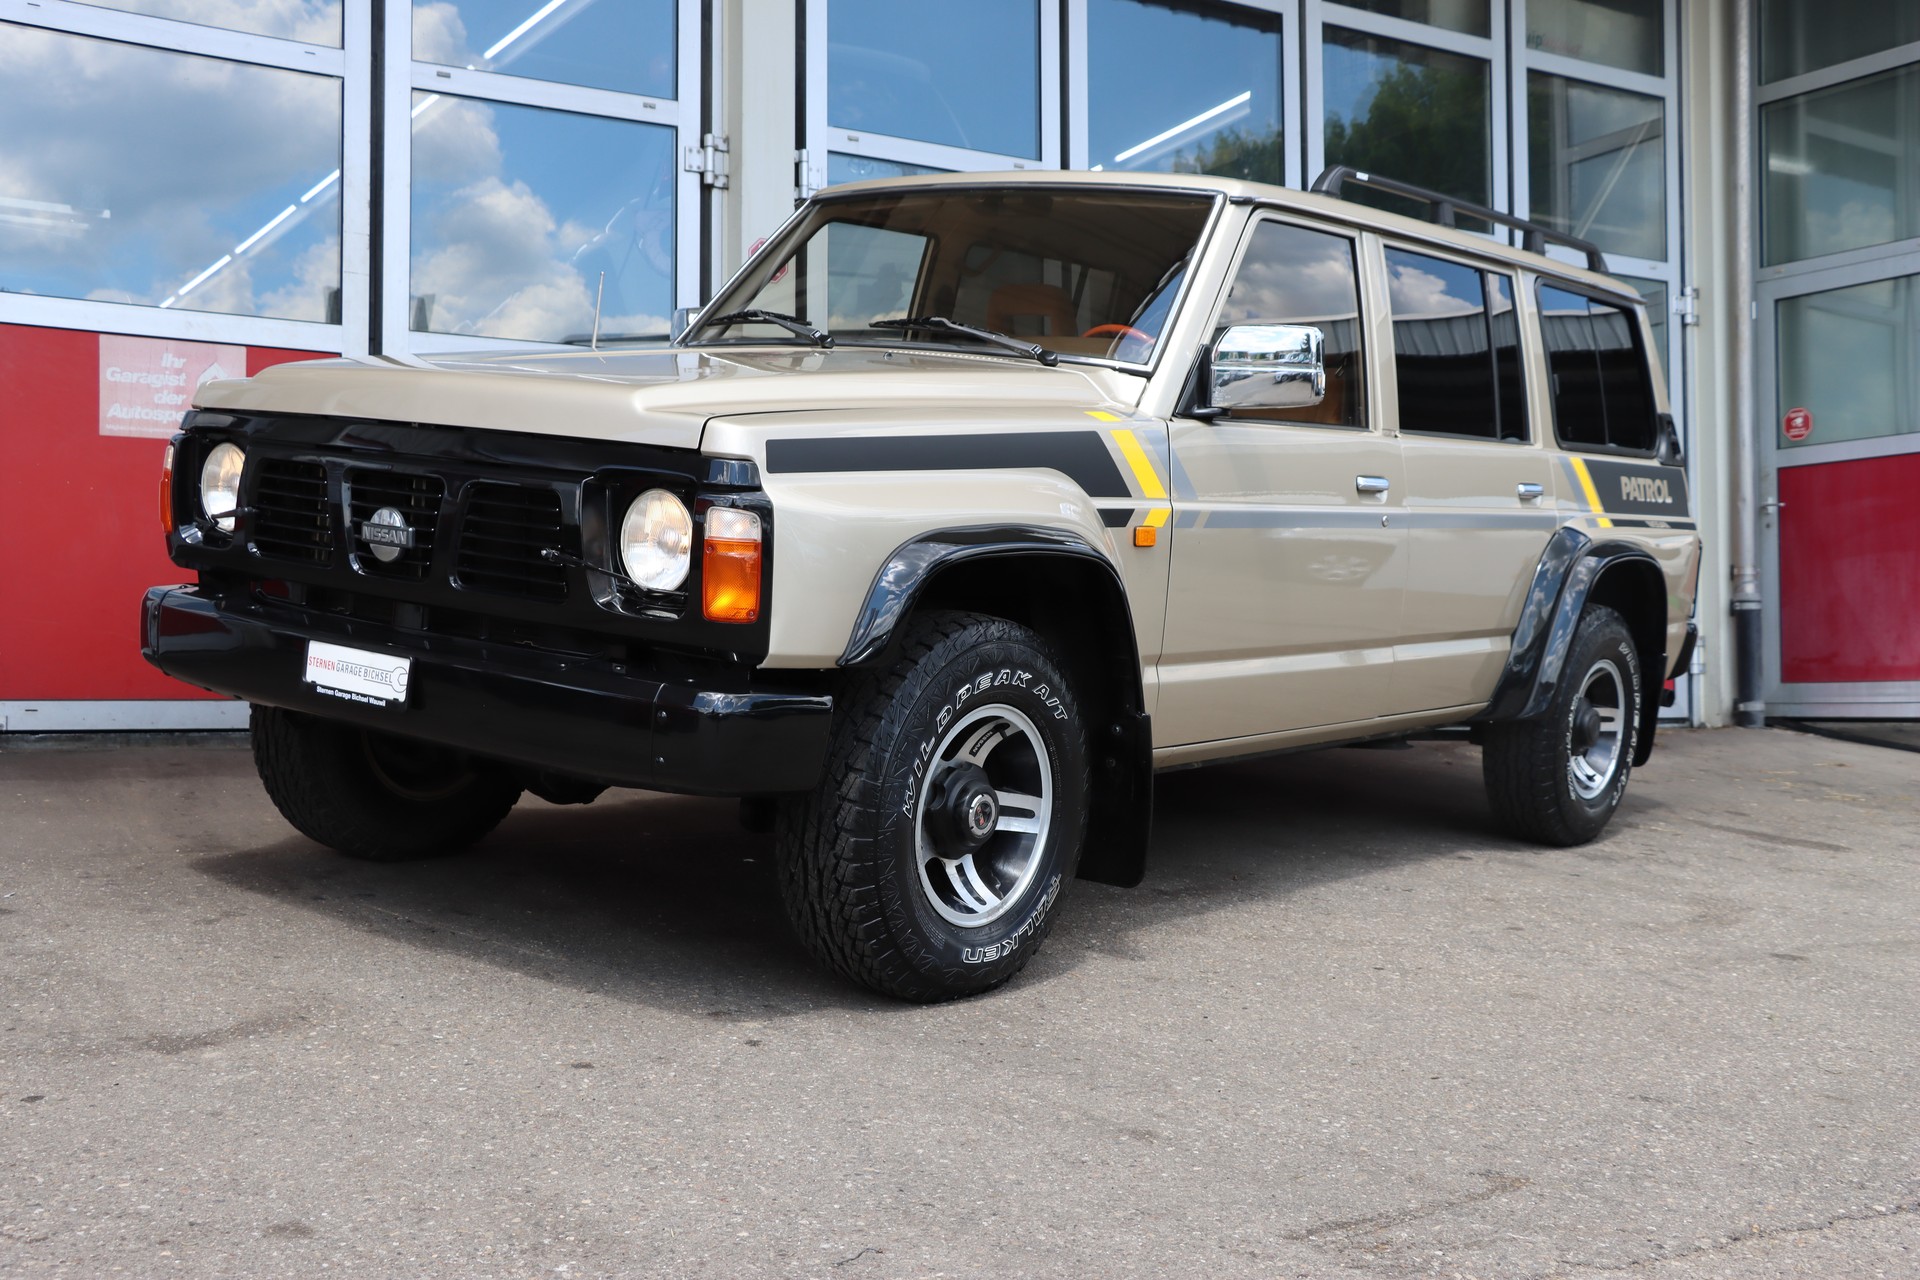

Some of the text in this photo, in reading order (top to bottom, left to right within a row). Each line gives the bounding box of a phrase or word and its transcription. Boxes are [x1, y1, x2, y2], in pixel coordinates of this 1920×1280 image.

[161, 352, 187, 369] Ihr
[105, 366, 187, 388] Garagist
[154, 389, 187, 406] der
[1620, 475, 1673, 504] PATROL
[362, 525, 407, 545] NISSAN
[308, 655, 393, 684] STERNEN GARAGE BICHSEL
[316, 685, 335, 696] Sternen
[334, 689, 352, 701] Garage
[351, 692, 369, 704] Bichsel
[902, 668, 1033, 820] WILDPEAK
[962, 873, 1062, 964] FALKEN
